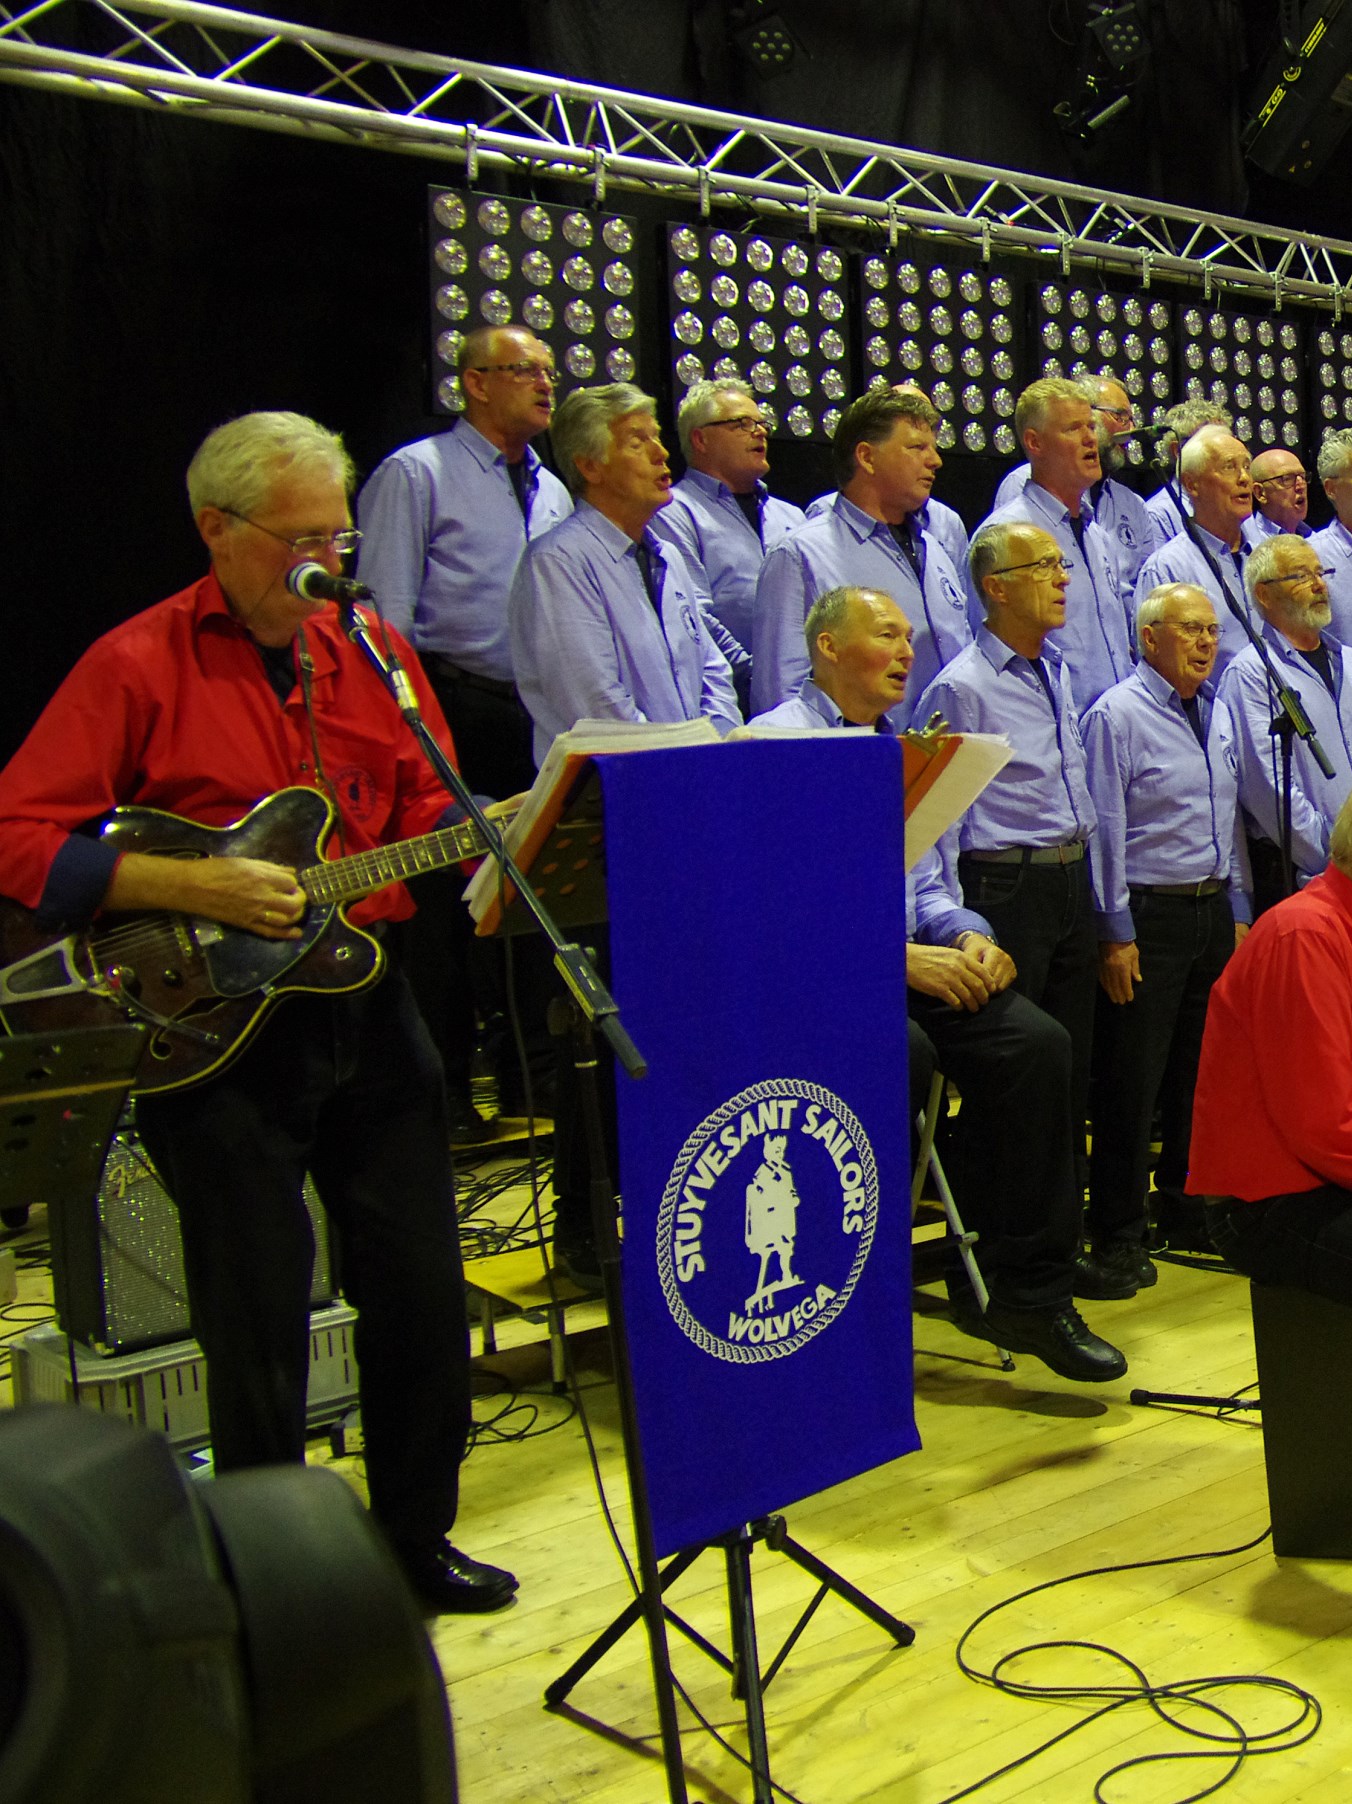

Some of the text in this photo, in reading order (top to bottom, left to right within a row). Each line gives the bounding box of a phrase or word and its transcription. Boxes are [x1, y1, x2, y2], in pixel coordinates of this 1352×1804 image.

[672, 1099, 865, 1283] STUYVESANT SAILORS
[728, 1283, 837, 1343] WOLVEGA
